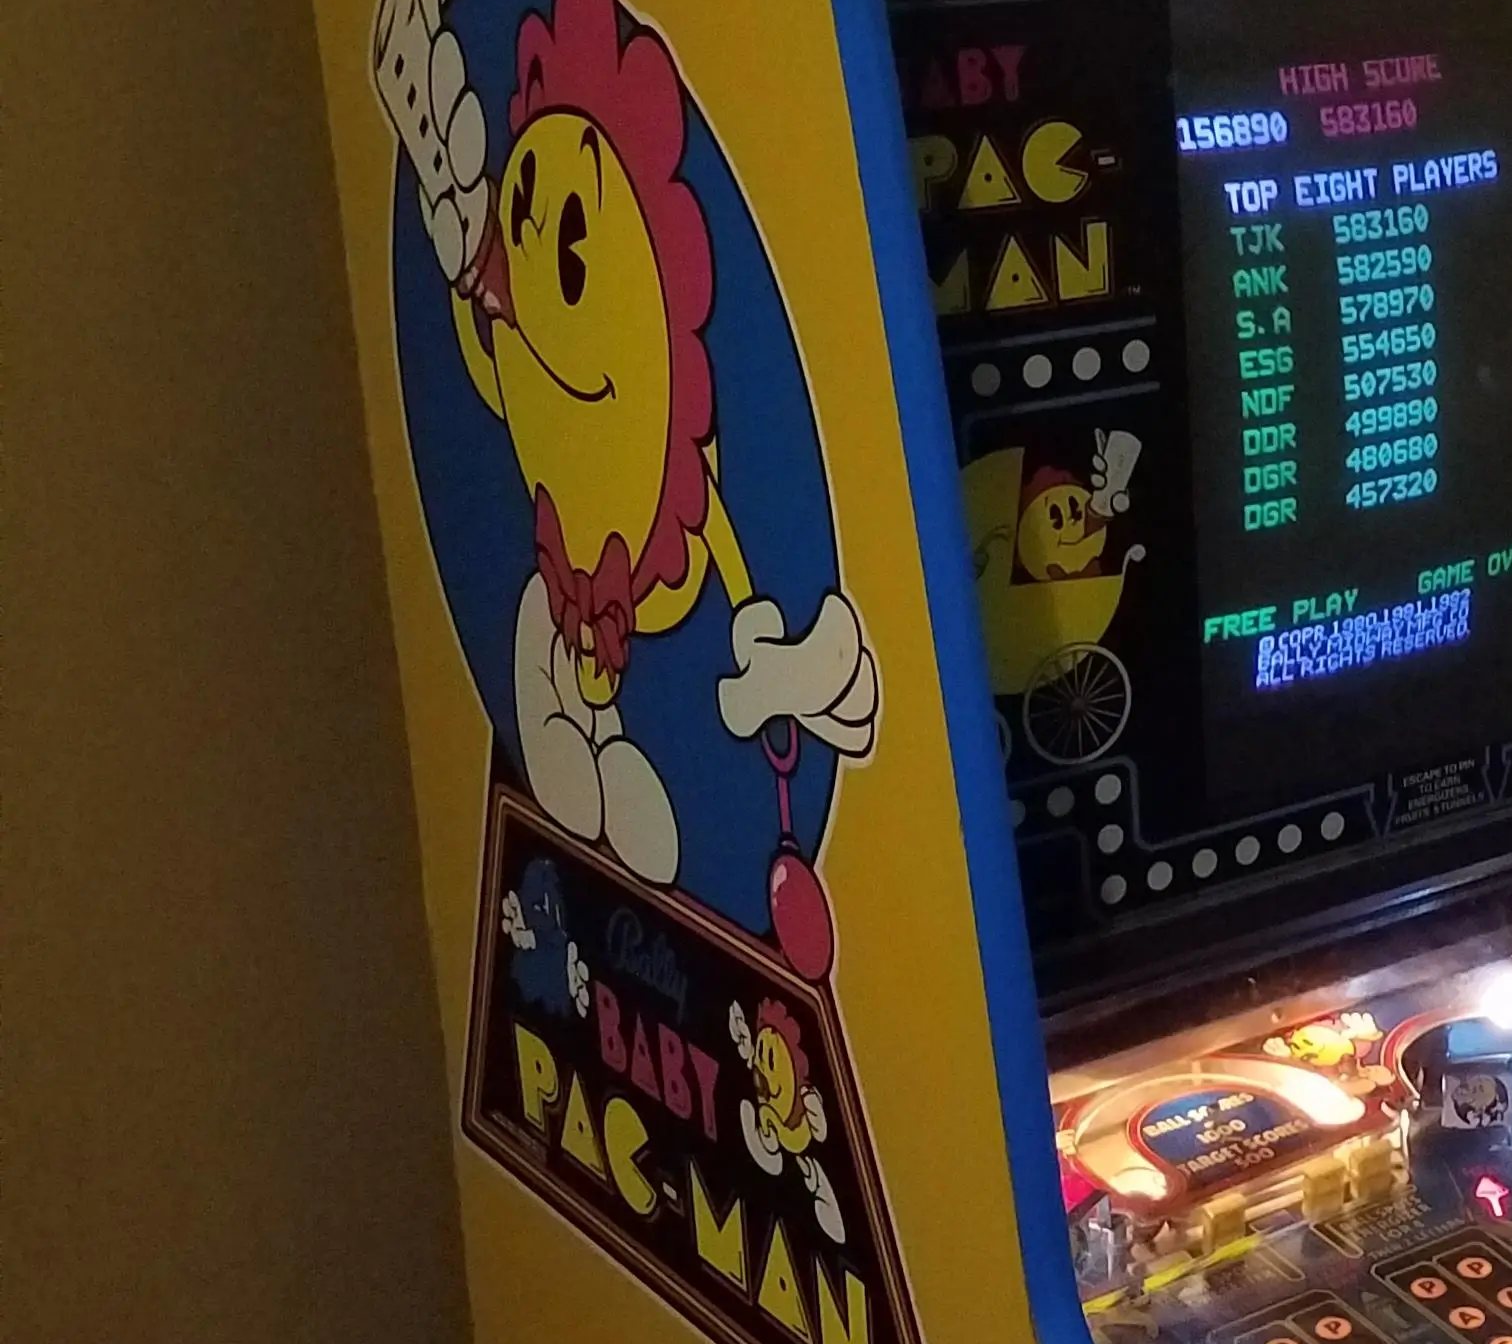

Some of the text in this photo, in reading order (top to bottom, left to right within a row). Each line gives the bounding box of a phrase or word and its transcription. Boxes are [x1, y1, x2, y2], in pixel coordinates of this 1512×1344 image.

[1278, 54, 1442, 96] HIGH SCORE
[1176, 98, 1418, 151] 156890 583160
[1224, 149, 1499, 215] TOP EIGHT PLAYERS
[1230, 203, 1430, 256] TJK 583160
[1232, 244, 1432, 299] ANK 582590
[1339, 282, 1435, 325] 578970
[1239, 322, 1437, 379] ESG 554650
[1343, 359, 1438, 402] 507530
[1345, 396, 1439, 439] 499890
[1345, 432, 1439, 475] 480680
[1345, 468, 1439, 510] 457320
[1417, 559, 1475, 595] GAME
[1203, 588, 1359, 643] FREE PLAY
[1256, 661, 1294, 689] ALL
[1300, 646, 1376, 678] RIGHTS
[1402, 767, 1441, 788] ESCAPE
[606, 905, 689, 1025] Bally
[595, 980, 719, 1143] BABY
[1142, 1114, 1191, 1137] BALL
[1196, 1119, 1247, 1144] 1000
[1177, 1142, 1244, 1177] TARGET
